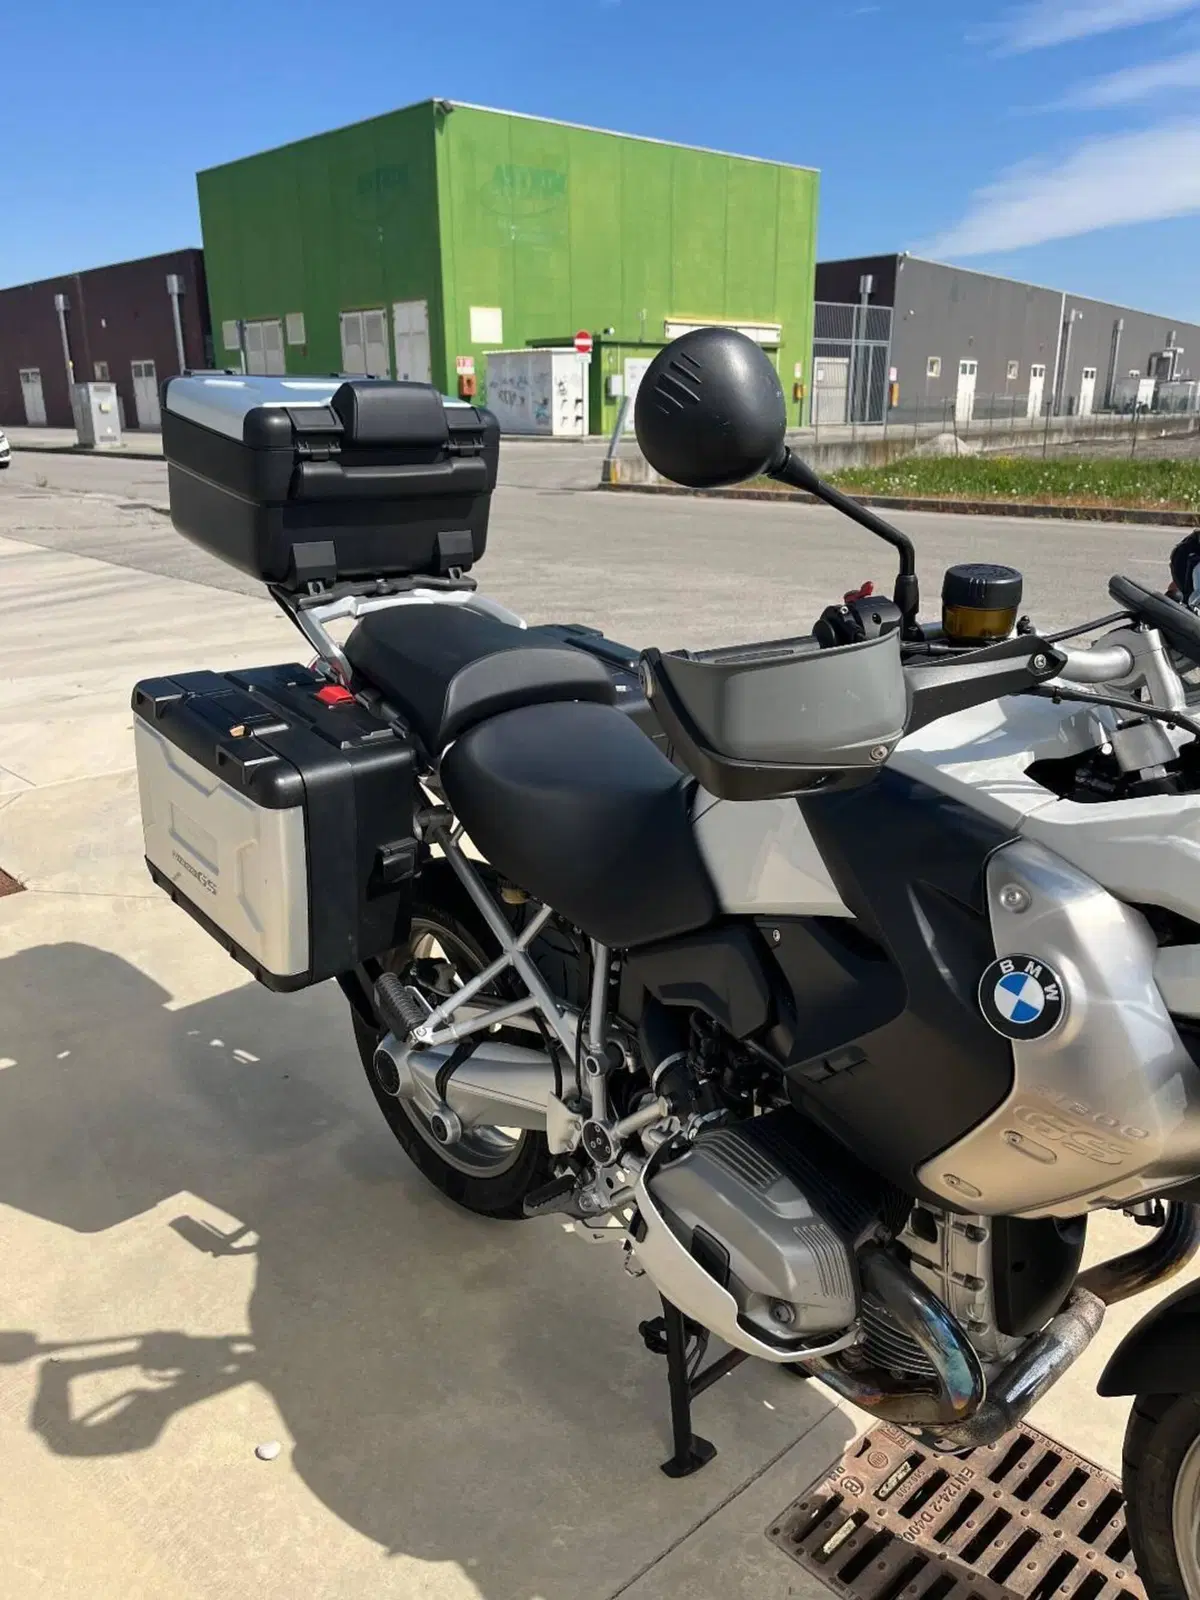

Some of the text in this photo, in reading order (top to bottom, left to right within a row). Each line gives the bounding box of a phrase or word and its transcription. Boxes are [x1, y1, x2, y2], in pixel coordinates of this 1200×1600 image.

[999, 959, 1060, 1001] BMW
[1016, 1421, 1109, 1483] TRAFFIC DIRECTIO
[902, 1511, 935, 1542] D400
